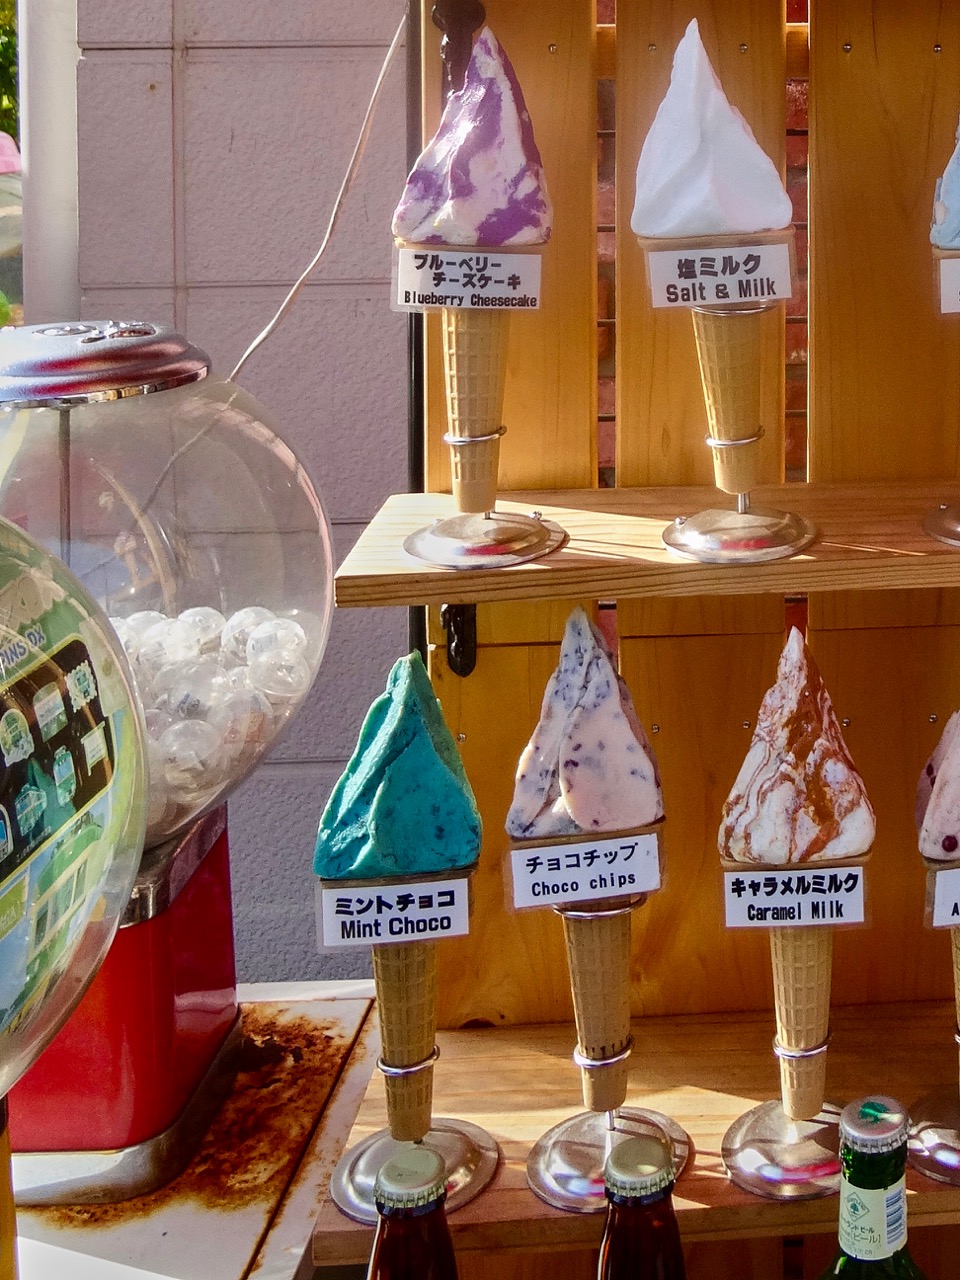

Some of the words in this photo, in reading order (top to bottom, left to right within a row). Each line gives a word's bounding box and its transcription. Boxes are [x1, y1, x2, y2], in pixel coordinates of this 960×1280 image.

[413, 254, 502, 273] ブルーベリー
[678, 254, 763, 280] 塩ミルク
[432, 272, 521, 290] チーズケーキ
[665, 282, 706, 303] Salt
[715, 283, 730, 300] &
[738, 277, 777, 298] Milk
[404, 291, 464, 307] Blueberry
[470, 294, 537, 308] Cheesecake
[525, 842, 639, 874] チョコチップ
[531, 879, 579, 897] Choco
[589, 872, 636, 890] chips
[731, 872, 859, 898] キャラメルミルク
[335, 889, 456, 916] ミントチョコ
[747, 902, 802, 921] Caramel
[811, 900, 844, 919] Milk
[341, 917, 382, 939] Mint
[388, 916, 452, 936] Choco
